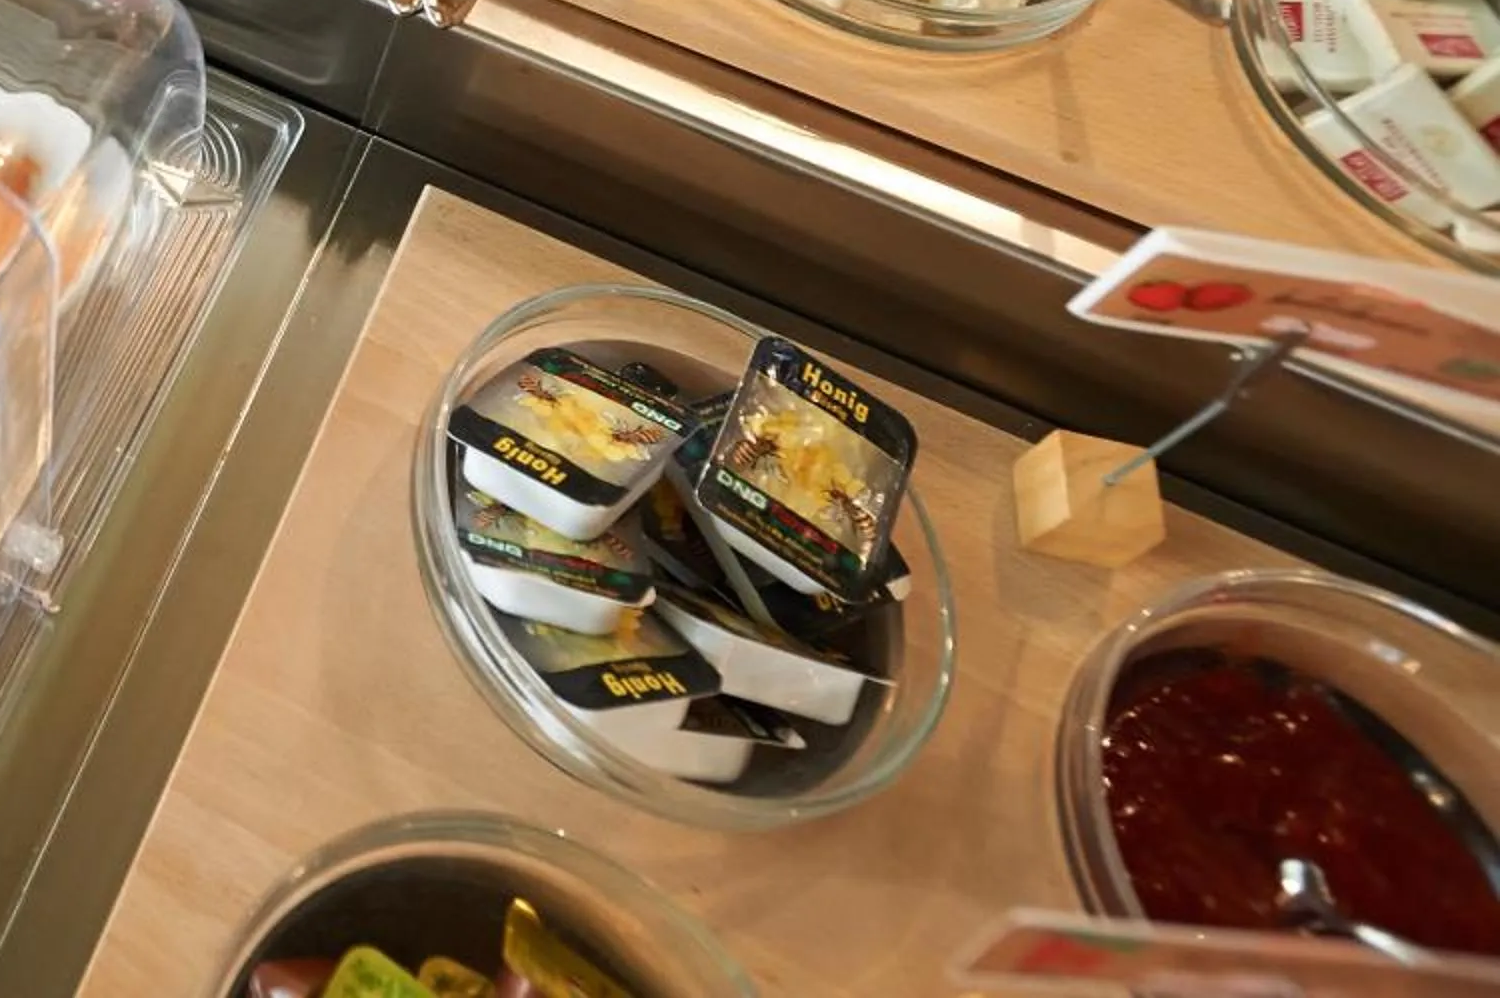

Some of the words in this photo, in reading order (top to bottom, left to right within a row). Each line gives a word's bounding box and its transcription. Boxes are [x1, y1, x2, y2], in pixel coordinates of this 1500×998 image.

[802, 361, 870, 423] Honig
[492, 435, 570, 487] Honig
[600, 671, 688, 700] Honig
